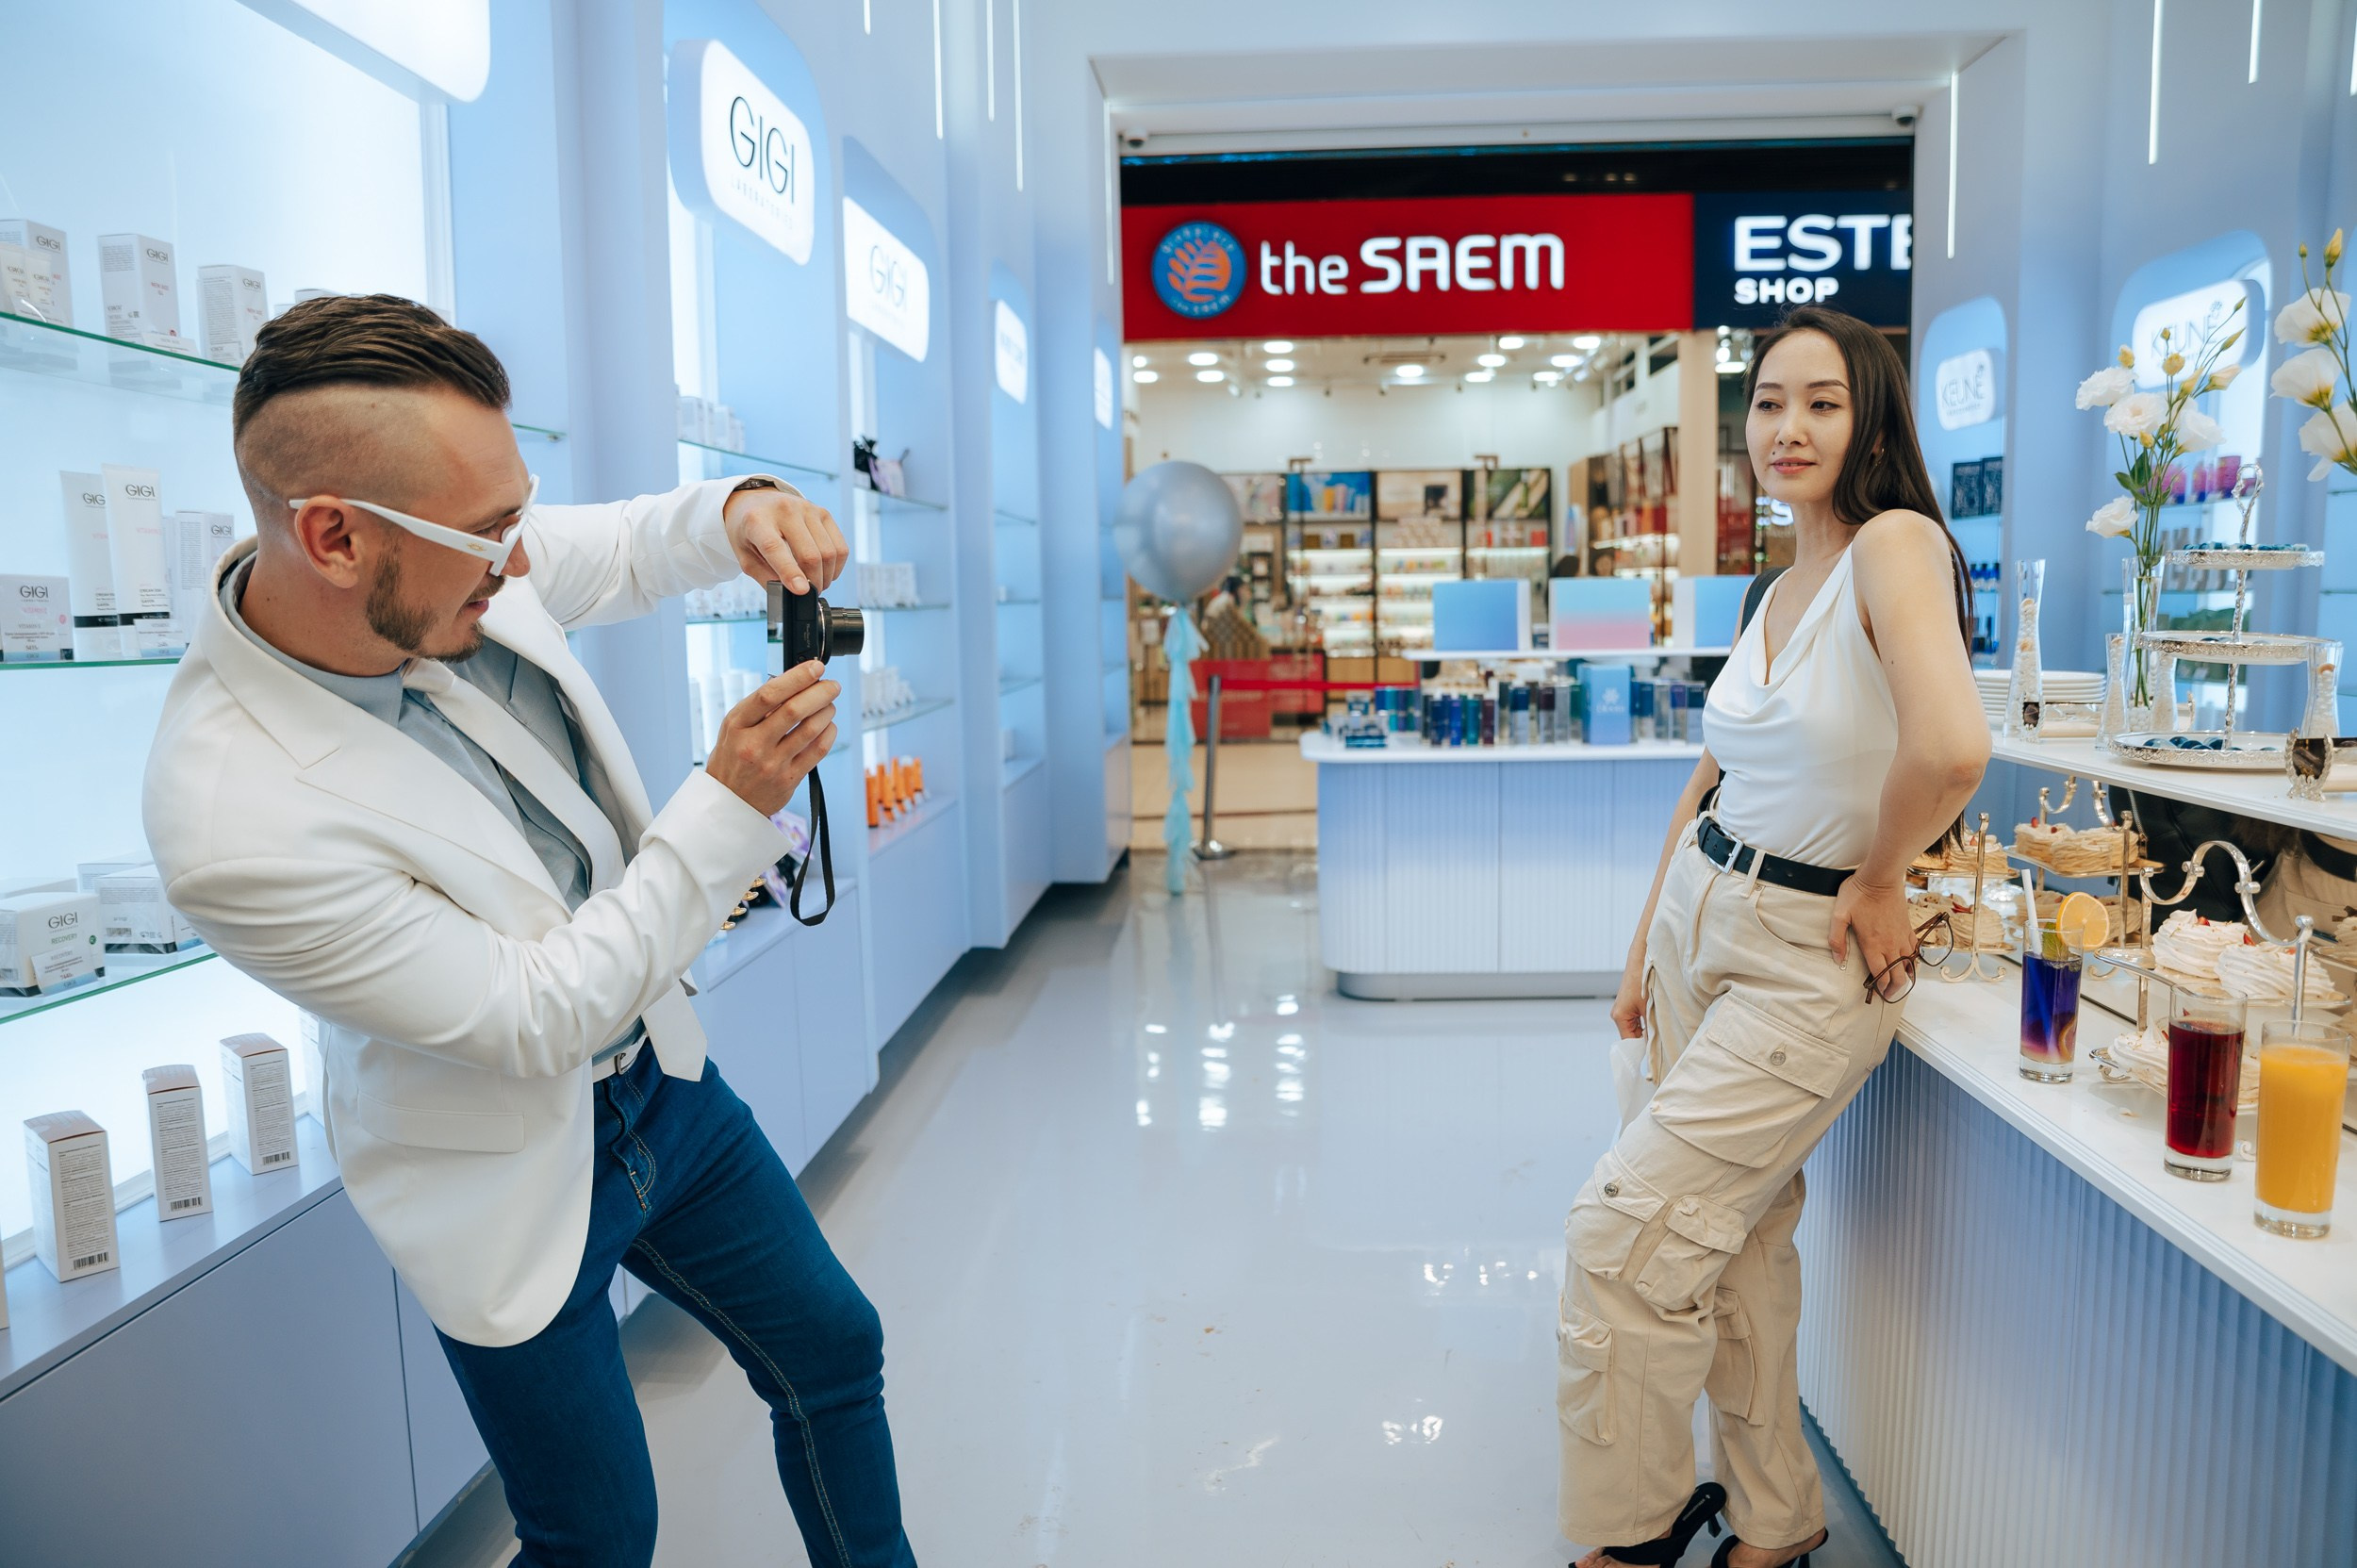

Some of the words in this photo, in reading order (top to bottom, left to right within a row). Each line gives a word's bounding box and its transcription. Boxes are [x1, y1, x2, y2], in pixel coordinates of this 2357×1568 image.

[729, 95, 795, 205] GIGI
[36, 235, 61, 252] GIGI
[146, 248, 169, 262] GIGI
[1260, 239, 1350, 296] the
[1359, 232, 1566, 295] SAEM
[869, 244, 908, 313] GIGI
[1734, 276, 1839, 305] SHOP
[125, 484, 156, 498] GIGI
[82, 493, 107, 506] GIG
[210, 524, 232, 536] GIGI
[20, 586, 49, 599] GIGI
[48, 912, 78, 930] GIGI
[51, 933, 77, 944] RECOVERY
